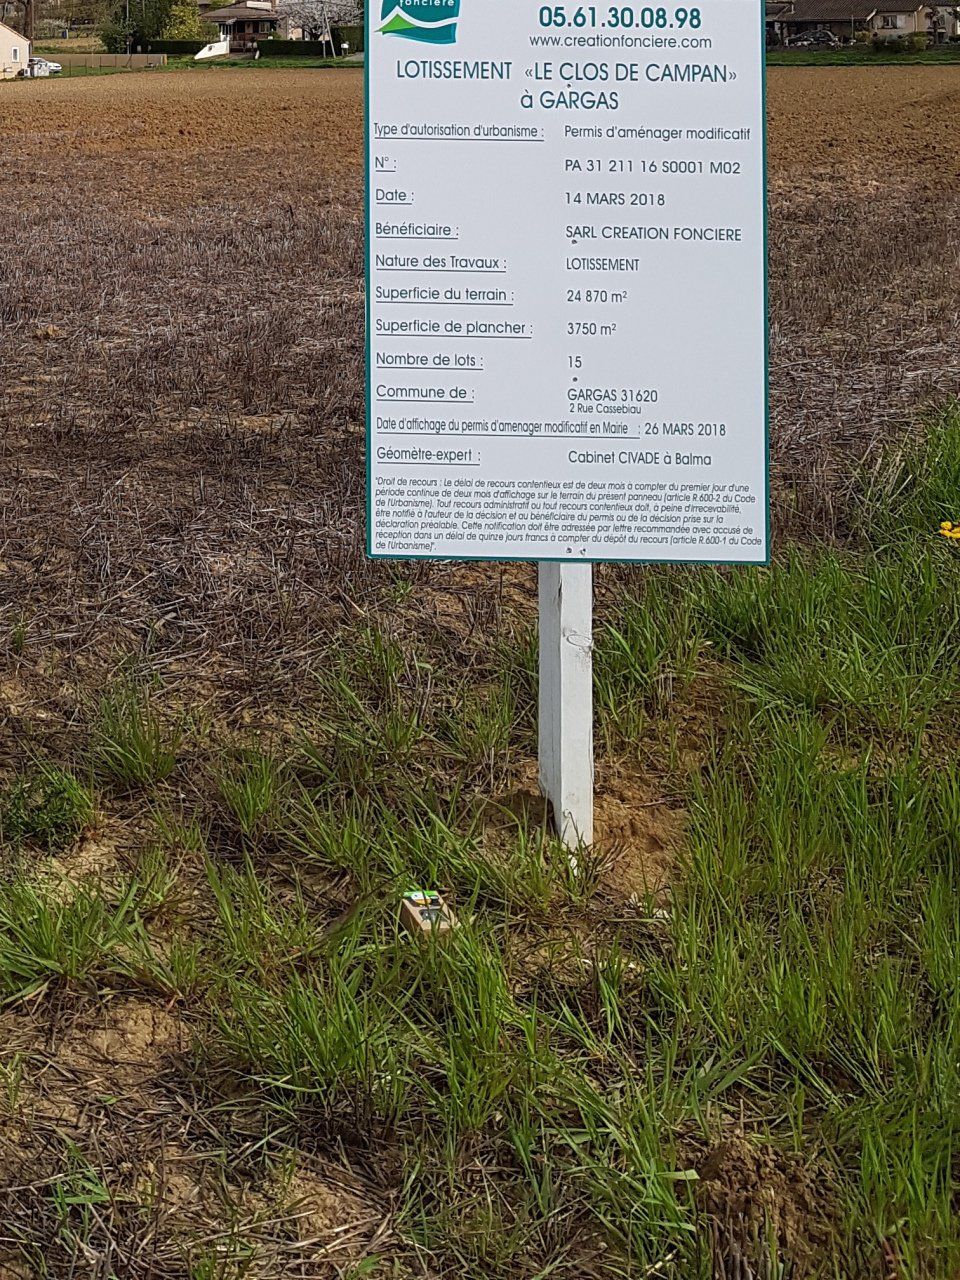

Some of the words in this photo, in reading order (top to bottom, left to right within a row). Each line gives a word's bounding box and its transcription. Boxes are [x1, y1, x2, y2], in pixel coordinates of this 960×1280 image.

[539, 6, 701, 29] 05.61.30.08.98
[529, 34, 712, 48] www.creationfonciere.com
[397, 60, 512, 80] LOTISSEMENT
[525, 62, 553, 80] «LE
[559, 62, 609, 81] CLOS
[615, 63, 638, 82] DE
[645, 63, 737, 82] CAMPAN»
[520, 89, 533, 108] à
[540, 90, 619, 110] GARGAS
[565, 159, 582, 172] PA
[586, 159, 601, 172] 31
[609, 160, 632, 172] 211
[641, 160, 658, 173] 16
[662, 161, 702, 174] S0001
[710, 161, 741, 174] M02
[375, 188, 407, 201] Date
[565, 192, 582, 204] 14
[586, 192, 625, 205] MARS
[630, 193, 665, 206] 2018
[376, 318, 440, 334] Superficie
[444, 320, 462, 333] de
[466, 320, 525, 335] plancher
[567, 322, 597, 335] 3750
[600, 323, 616, 335] m²
[567, 388, 617, 402] GARGAS
[621, 389, 658, 403] 31620
[570, 403, 575, 413] 2
[577, 402, 594, 413] Rue
[595, 403, 642, 414] Cassebiau
